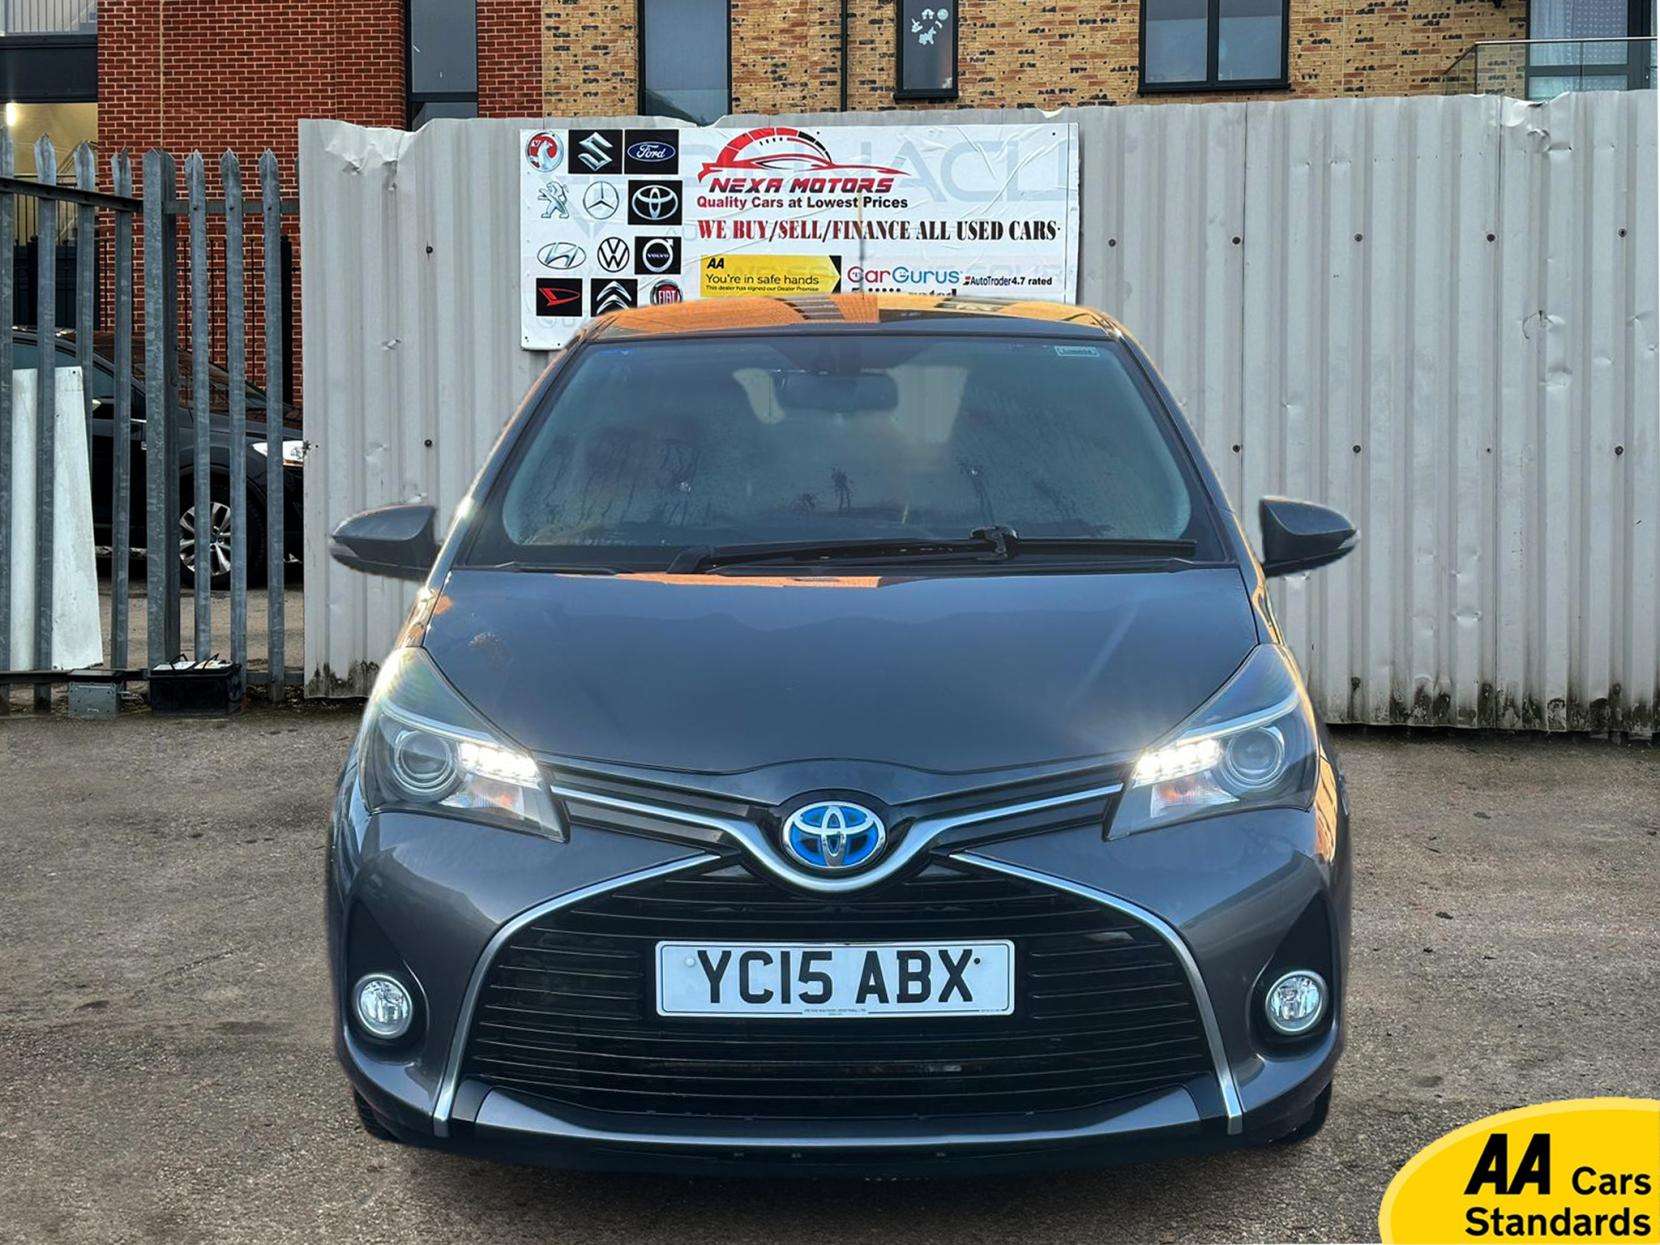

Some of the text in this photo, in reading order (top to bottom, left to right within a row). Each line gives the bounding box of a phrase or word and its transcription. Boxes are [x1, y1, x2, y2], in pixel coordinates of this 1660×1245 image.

[636, 144, 666, 158] Ford
[709, 178, 894, 193] NEXA MOTORS
[697, 196, 908, 210] Quality Cars at Lowest Prices
[697, 220, 727, 240] WE
[916, 220, 950, 240] ALL
[957, 220, 1004, 240] USED
[1009, 220, 1057, 240] CARS
[707, 258, 725, 269] AA
[706, 274, 819, 285] You're in safe hands
[847, 266, 960, 284] CarGurus
[1028, 276, 1053, 286] rated
[658, 290, 676, 304] FIAT
[697, 950, 973, 1004] YC15 ABX
